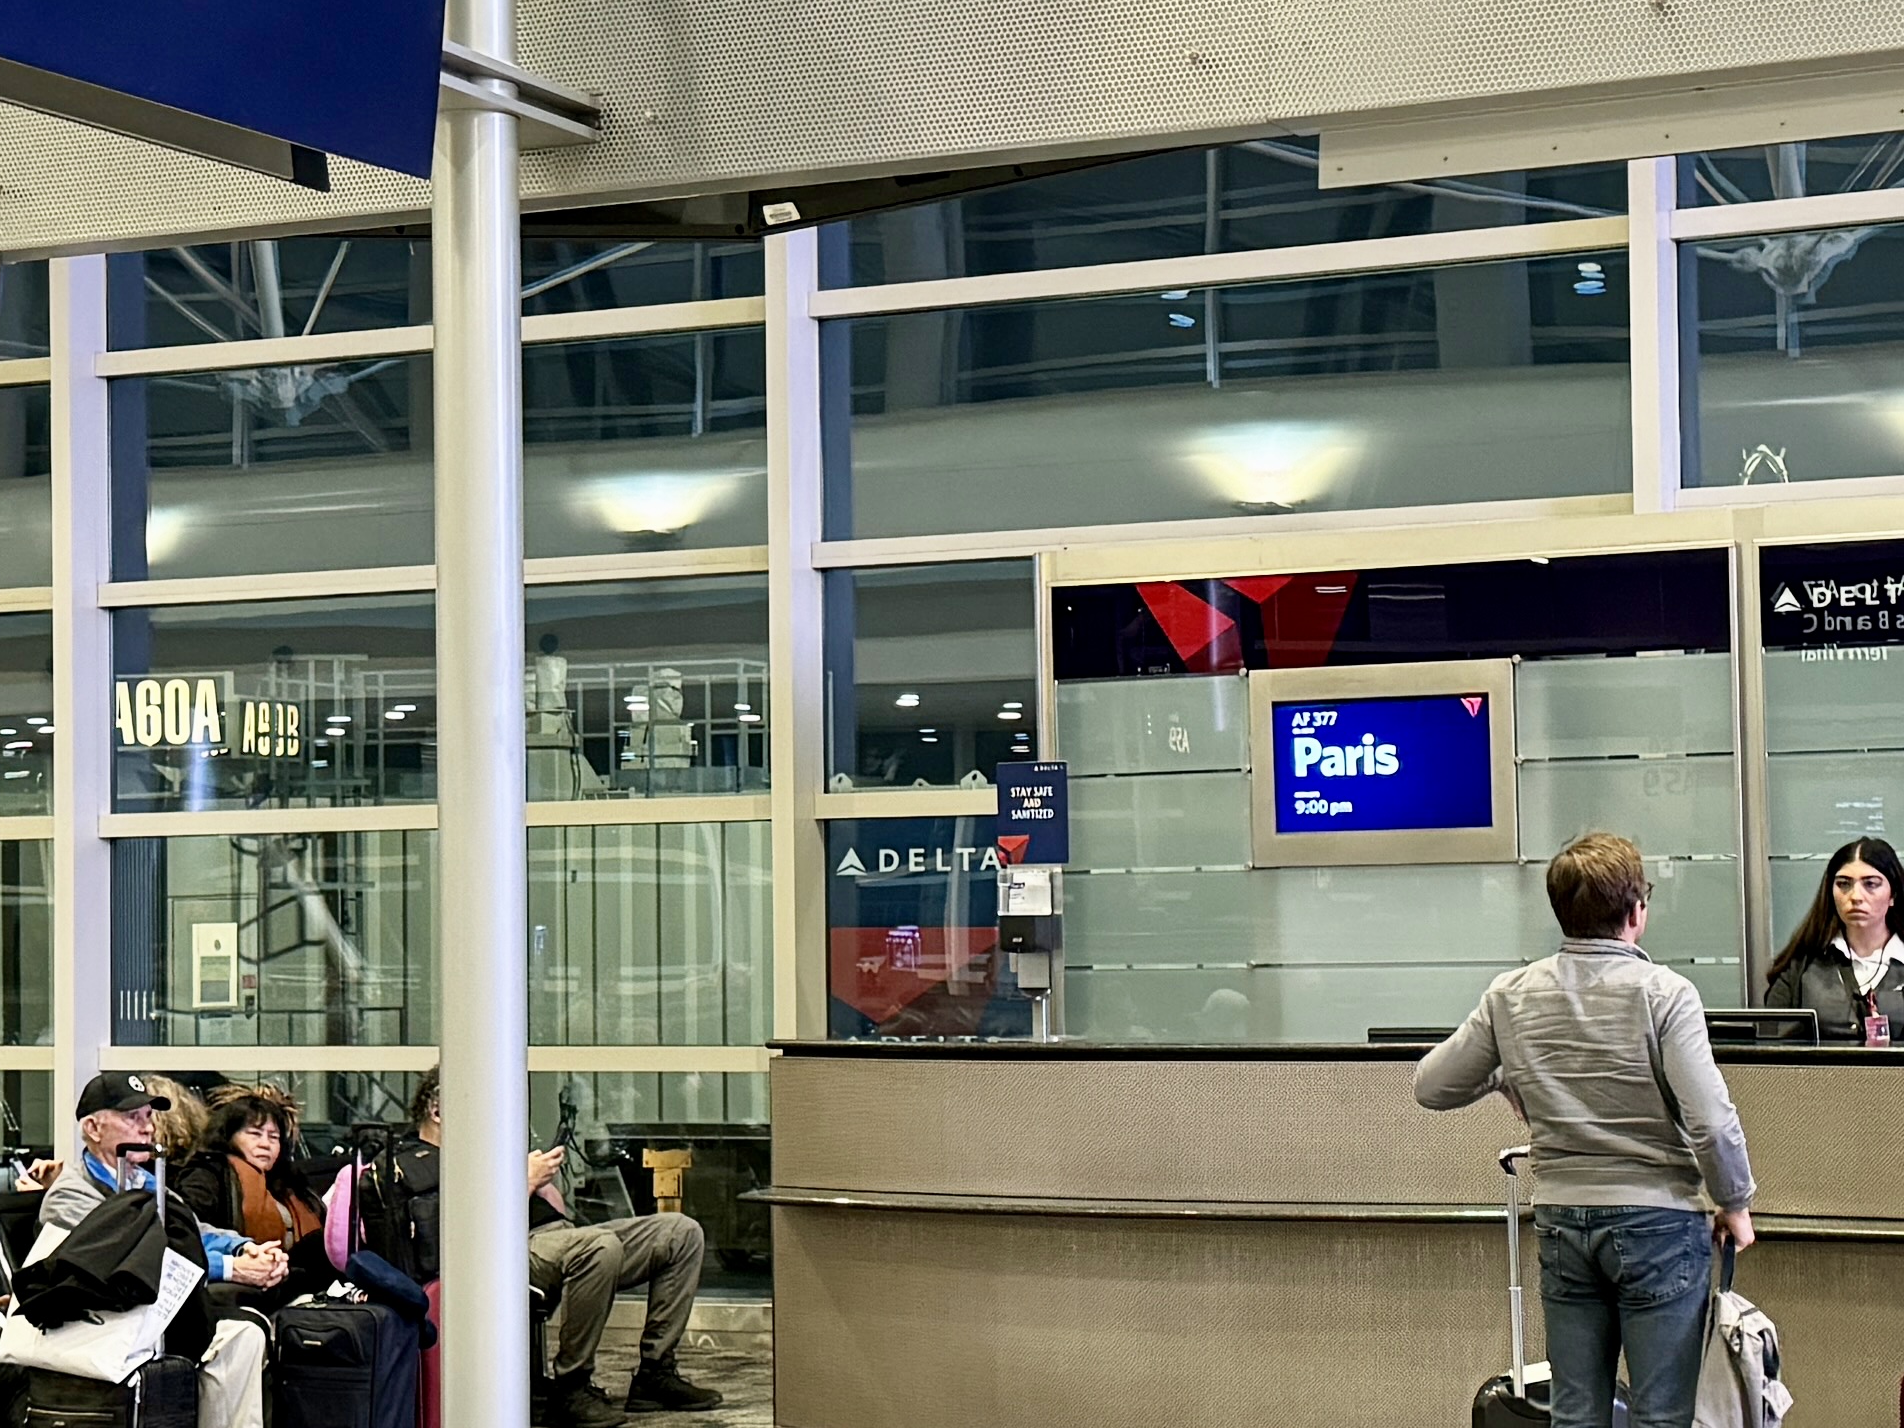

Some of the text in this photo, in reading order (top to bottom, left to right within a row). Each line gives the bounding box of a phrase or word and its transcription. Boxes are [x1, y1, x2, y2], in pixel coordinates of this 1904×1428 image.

[115, 678, 222, 746] A60A
[1291, 710, 1338, 727] AF 377
[1293, 732, 1400, 778] Paris
[1010, 785, 1054, 798] STAY SAFE
[1011, 808, 1055, 820] SANITIZED
[1294, 799, 1353, 816] 9:00 pm
[878, 847, 1002, 873] DELTA
